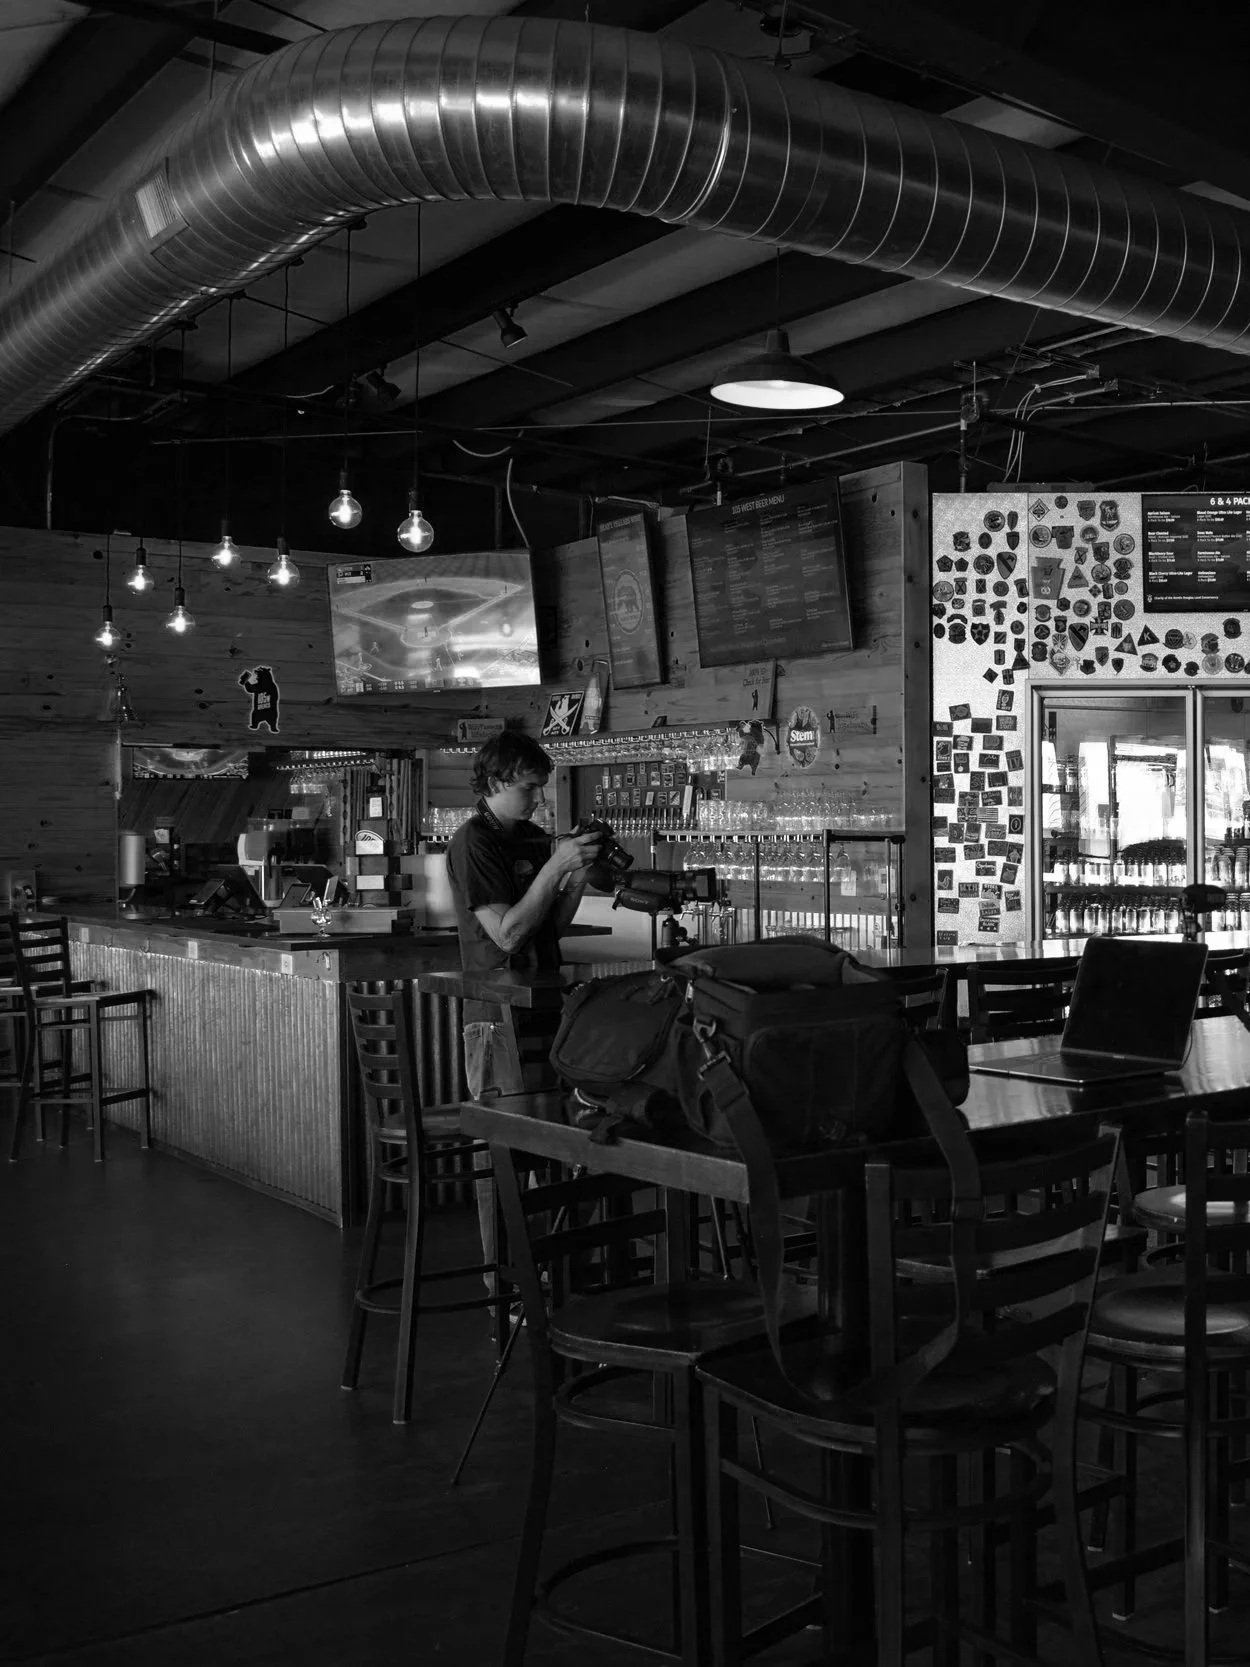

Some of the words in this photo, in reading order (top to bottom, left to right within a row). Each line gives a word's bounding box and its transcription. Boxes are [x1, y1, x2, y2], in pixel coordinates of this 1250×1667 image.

[740, 501, 755, 512] WEST
[755, 498, 768, 509] BEER
[768, 494, 785, 505] MENU
[1210, 497, 1216, 506] 6
[1217, 497, 1224, 506] &
[1226, 497, 1231, 506] 4
[790, 729, 813, 742] Stem
